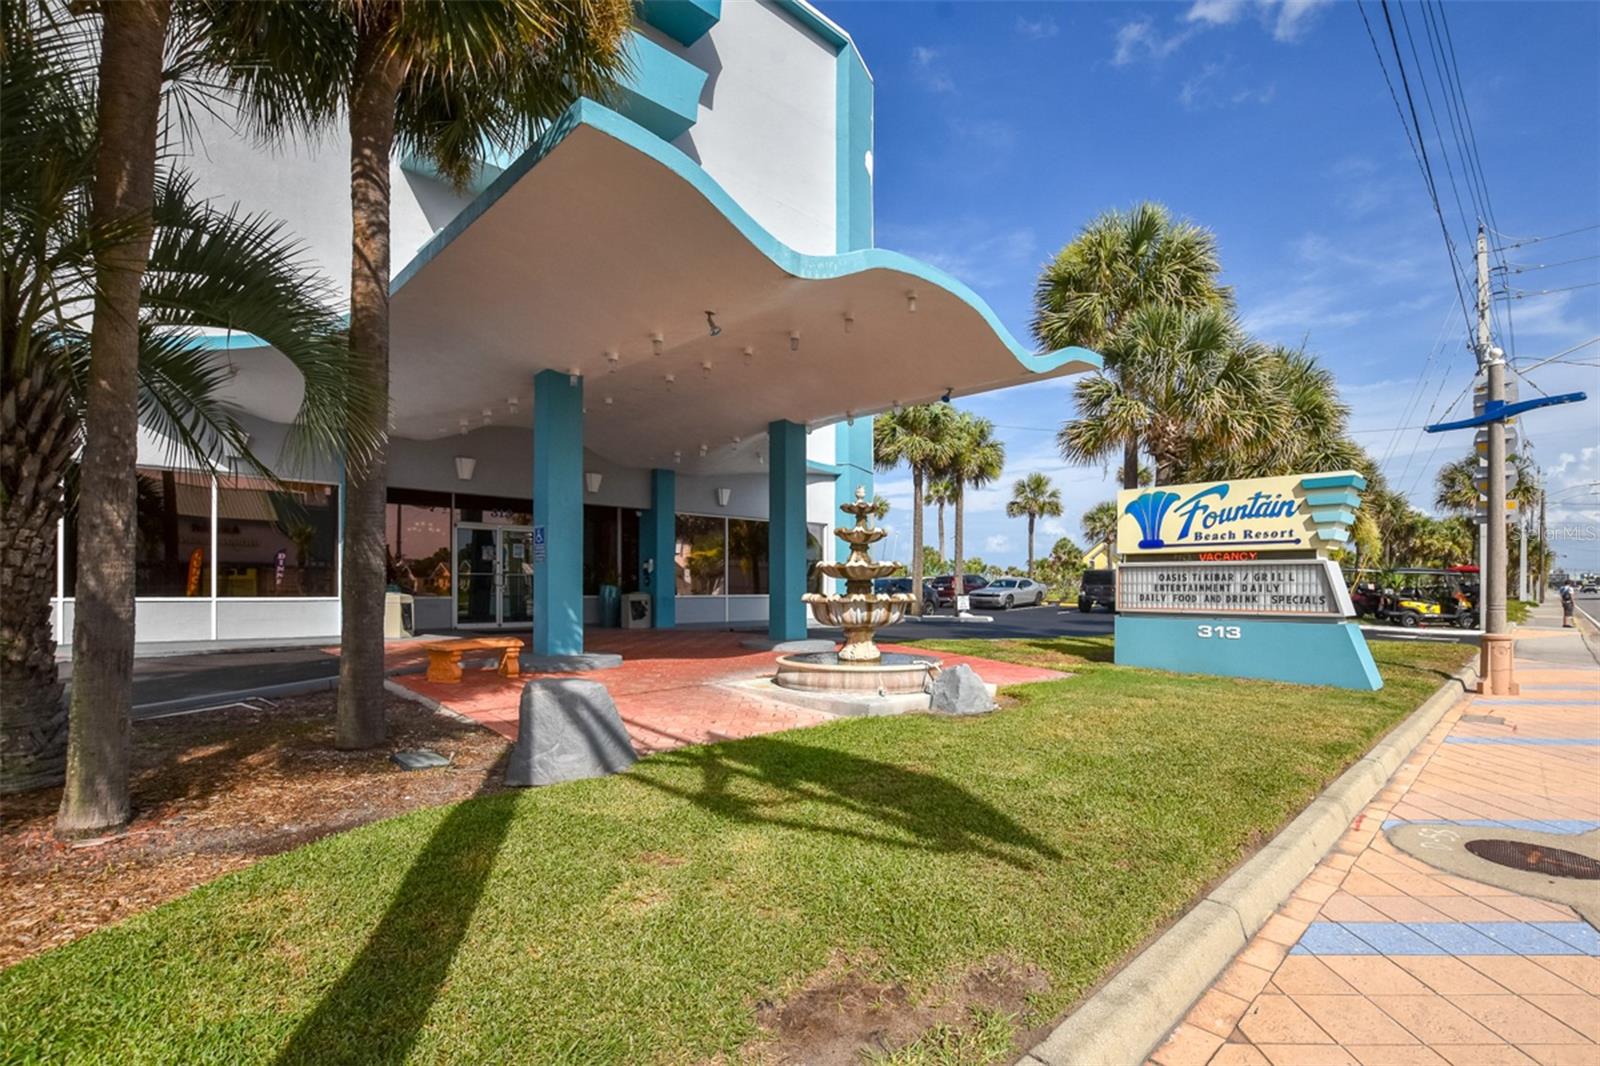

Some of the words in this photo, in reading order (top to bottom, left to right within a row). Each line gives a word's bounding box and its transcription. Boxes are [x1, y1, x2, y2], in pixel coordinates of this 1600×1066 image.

[1174, 484, 1300, 540] Fountain
[1194, 530, 1236, 541] Beach
[1243, 529, 1294, 540] Resort
[1199, 552, 1257, 562] VACANCY
[1158, 572, 1188, 582] OASIS
[1154, 583, 1231, 593] ENTERTAINMENT
[1242, 583, 1280, 593] DAILY
[1139, 593, 1166, 602] DAILY
[1173, 594, 1198, 603] FOOD
[1204, 594, 1223, 604] AND
[1226, 594, 1258, 604] DRINK
[1271, 595, 1326, 605] SPECIALS
[1197, 624, 1241, 639] 313
